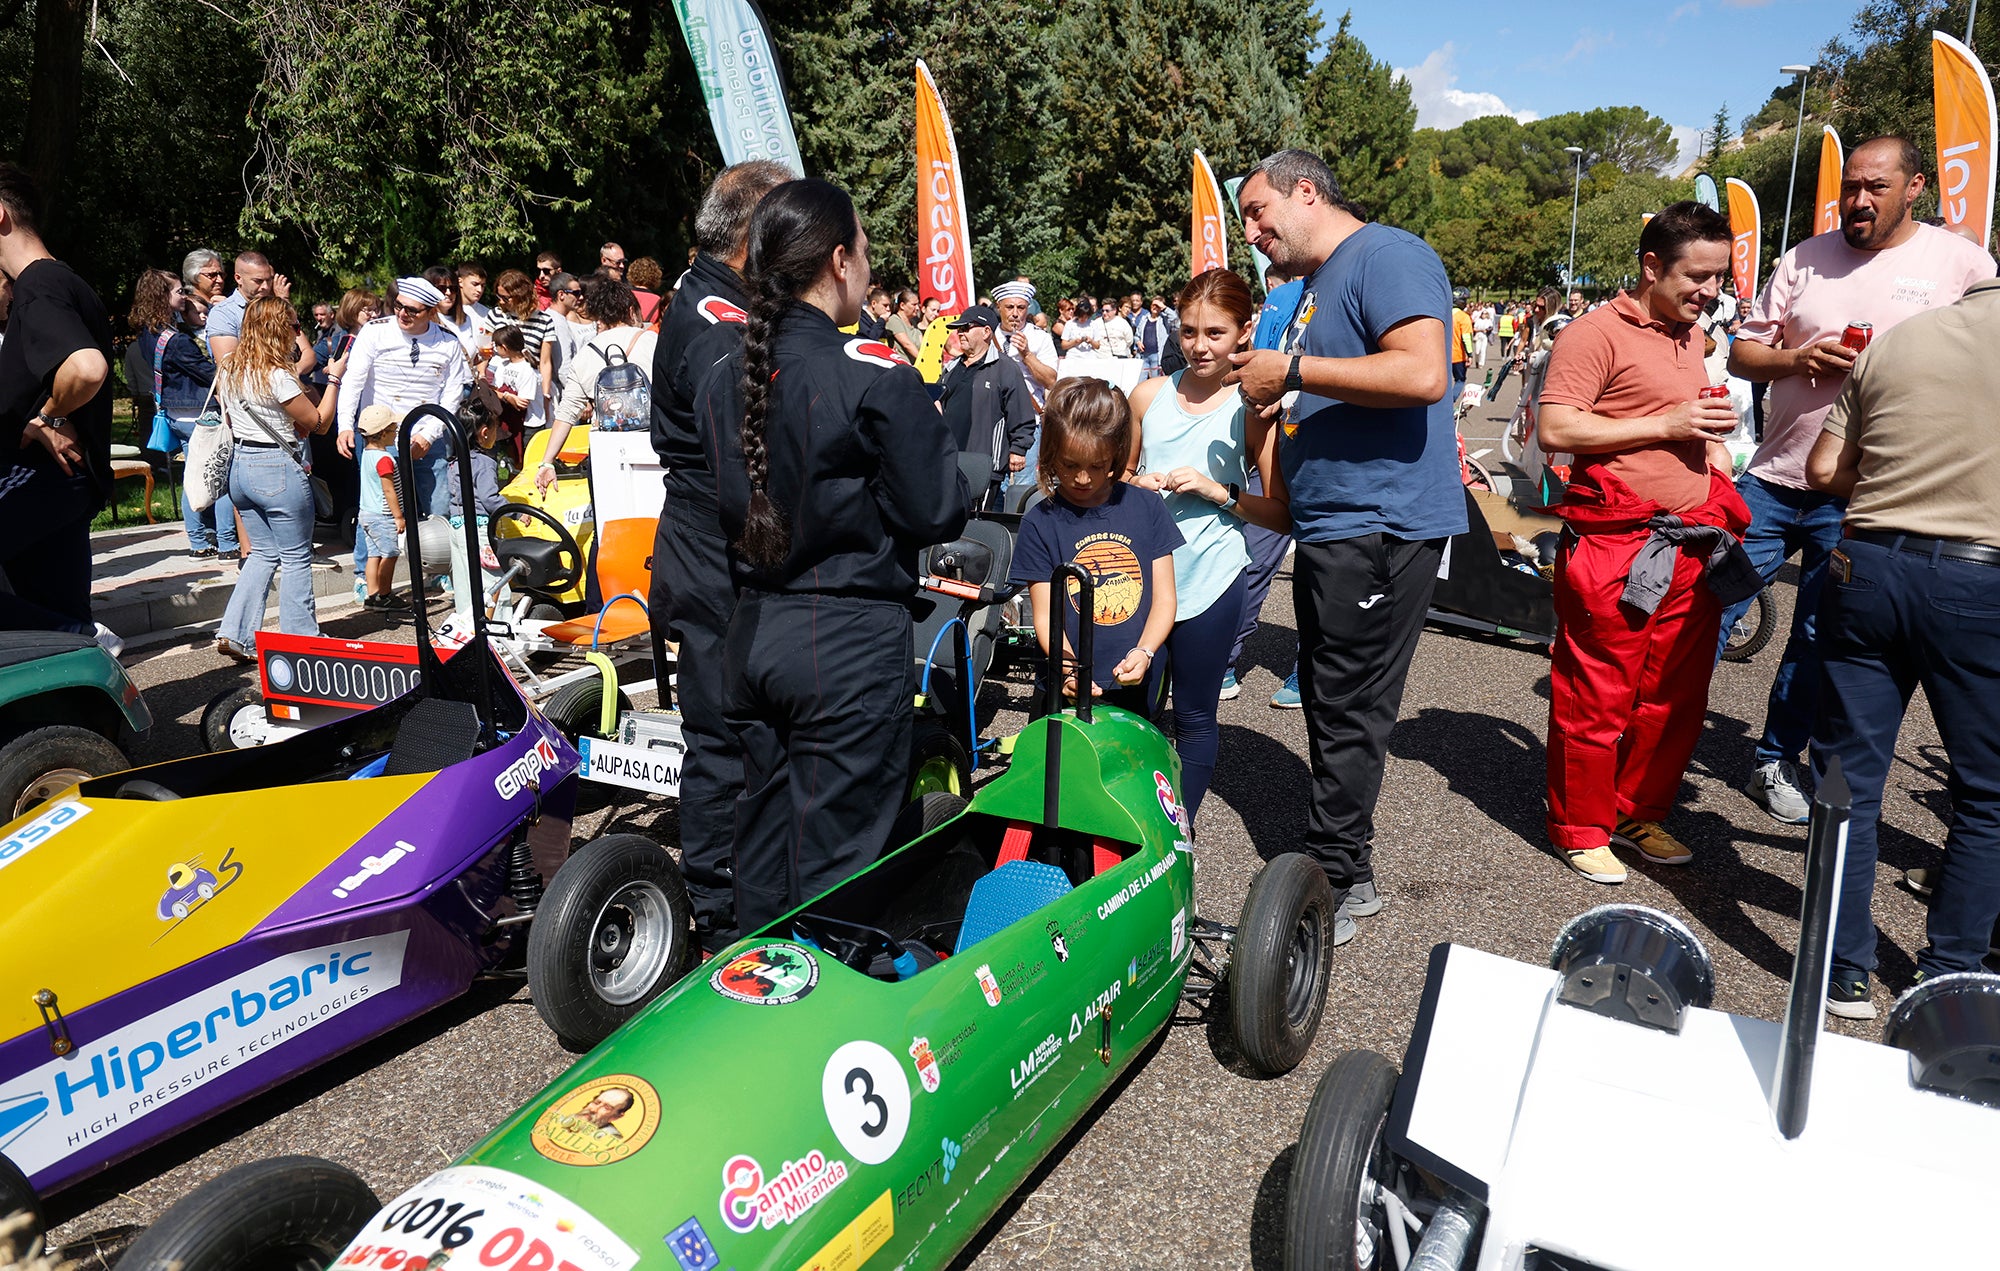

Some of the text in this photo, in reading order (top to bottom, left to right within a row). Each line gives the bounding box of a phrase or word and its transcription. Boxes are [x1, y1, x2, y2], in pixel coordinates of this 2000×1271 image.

[596, 754, 650, 781] AUPASA
[1097, 850, 1178, 920] CAMINO DE LA MIRANDA
[998, 961, 1025, 986] Junta de
[1084, 979, 1121, 1026] ALTAIR
[54, 951, 372, 1116] Hiperbaric
[937, 1021, 977, 1058] universidad
[1034, 1033, 1055, 1056] WIND
[1035, 1037, 1063, 1068] POWER
[67, 984, 371, 1147] HIGH PRESSURE TECHNOLOGIES
[1010, 1051, 1035, 1089] LM
[844, 1067, 888, 1138] 3
[765, 1164, 845, 1226] de la Miranda
[897, 1157, 941, 1216] FECYT
[381, 1197, 485, 1249] 0016
[578, 1234, 620, 1268] repsol
